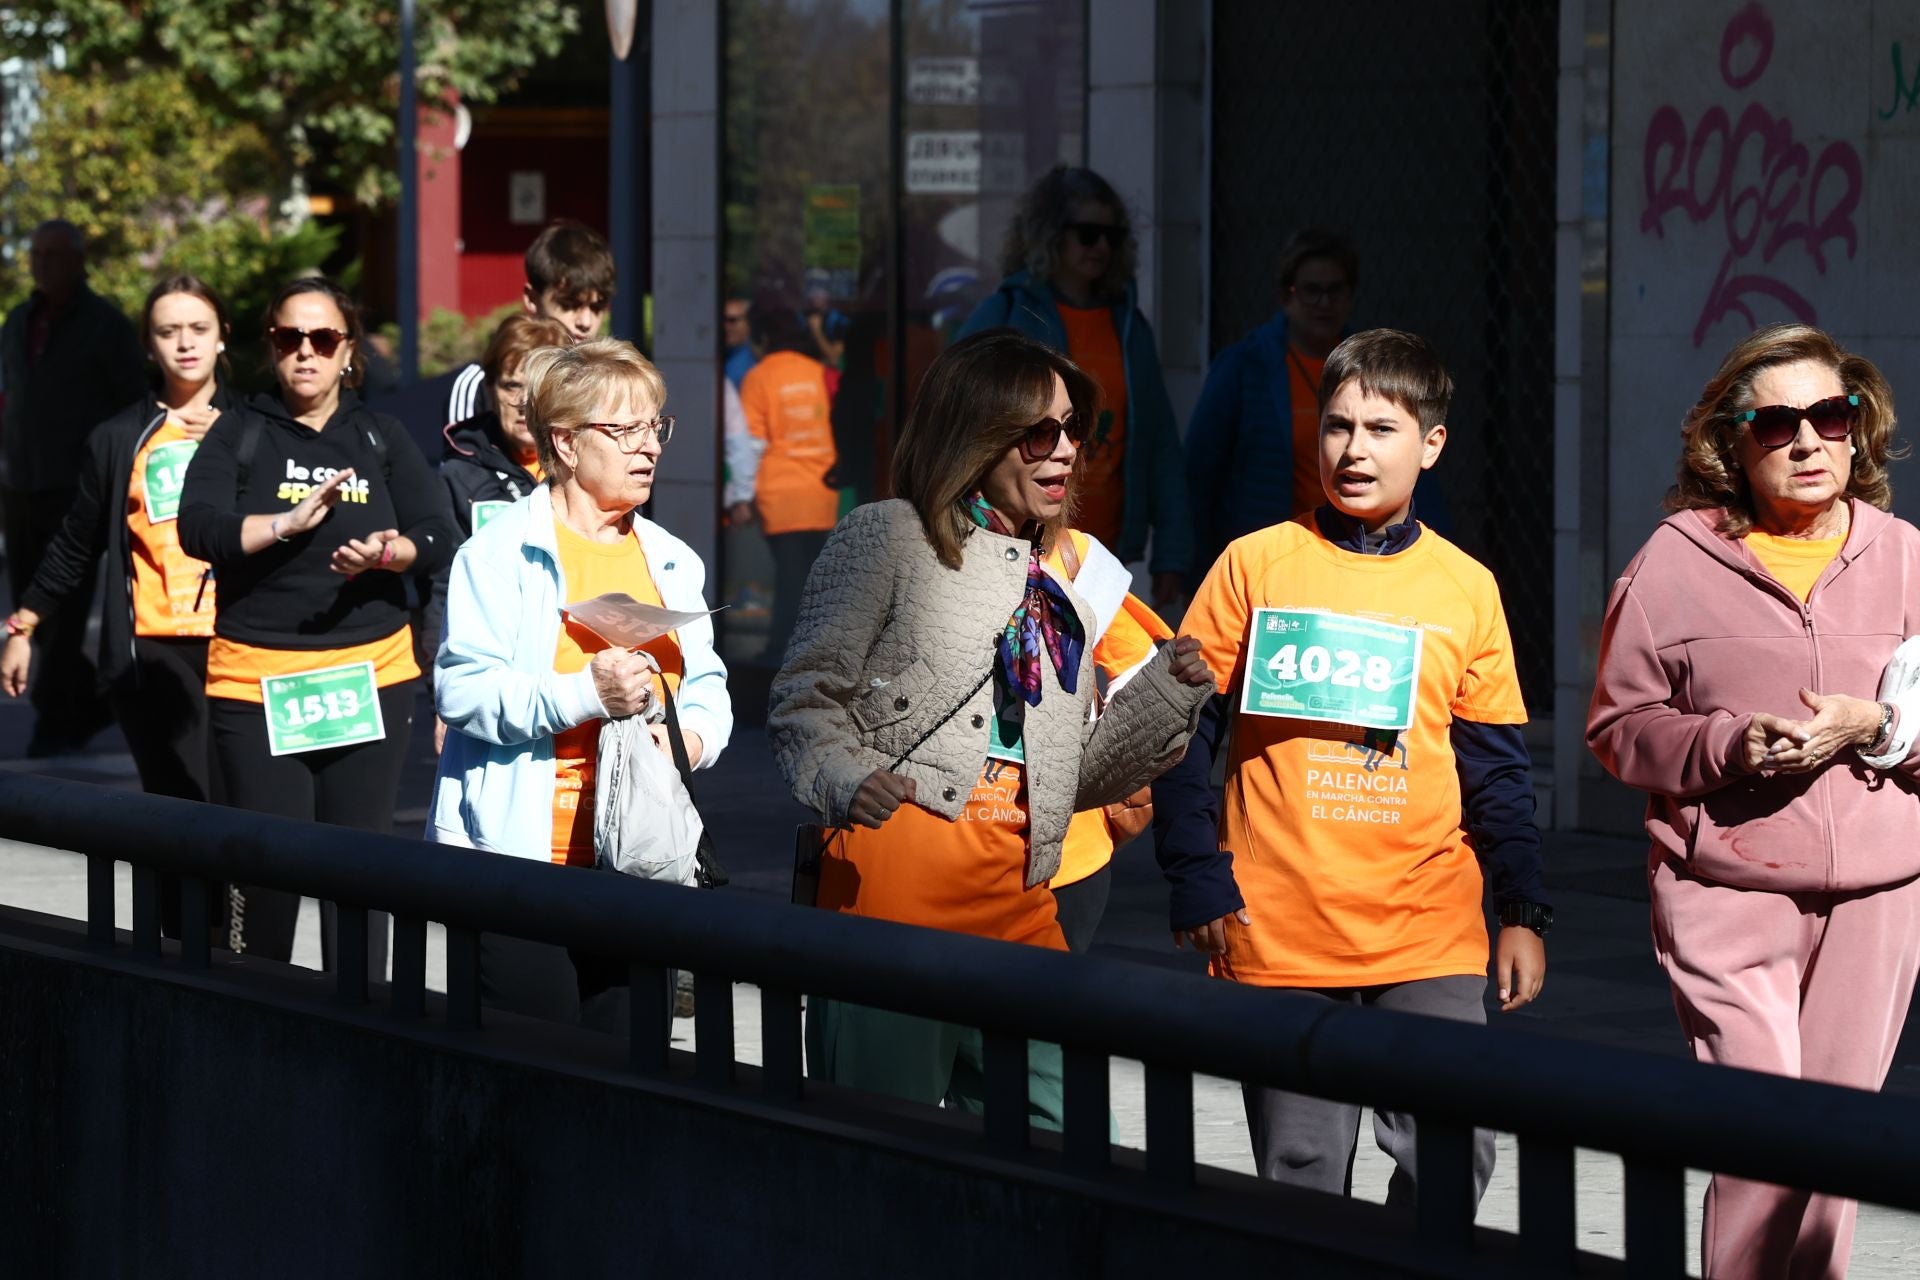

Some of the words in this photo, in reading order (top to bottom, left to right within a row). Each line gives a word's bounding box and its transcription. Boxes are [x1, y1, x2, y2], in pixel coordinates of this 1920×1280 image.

[286, 459, 310, 480] le
[277, 480, 369, 504] sptif
[1268, 644, 1392, 692] 4028
[284, 688, 360, 725] 1513
[1306, 769, 1408, 793] PALENCIA
[560, 793, 577, 809] EL
[1306, 790, 1319, 799] EN
[1321, 791, 1365, 804] MARCHA
[1367, 795, 1407, 805] CONTRA
[1311, 805, 1328, 819] EL
[1331, 805, 1401, 824] CÁNCER
